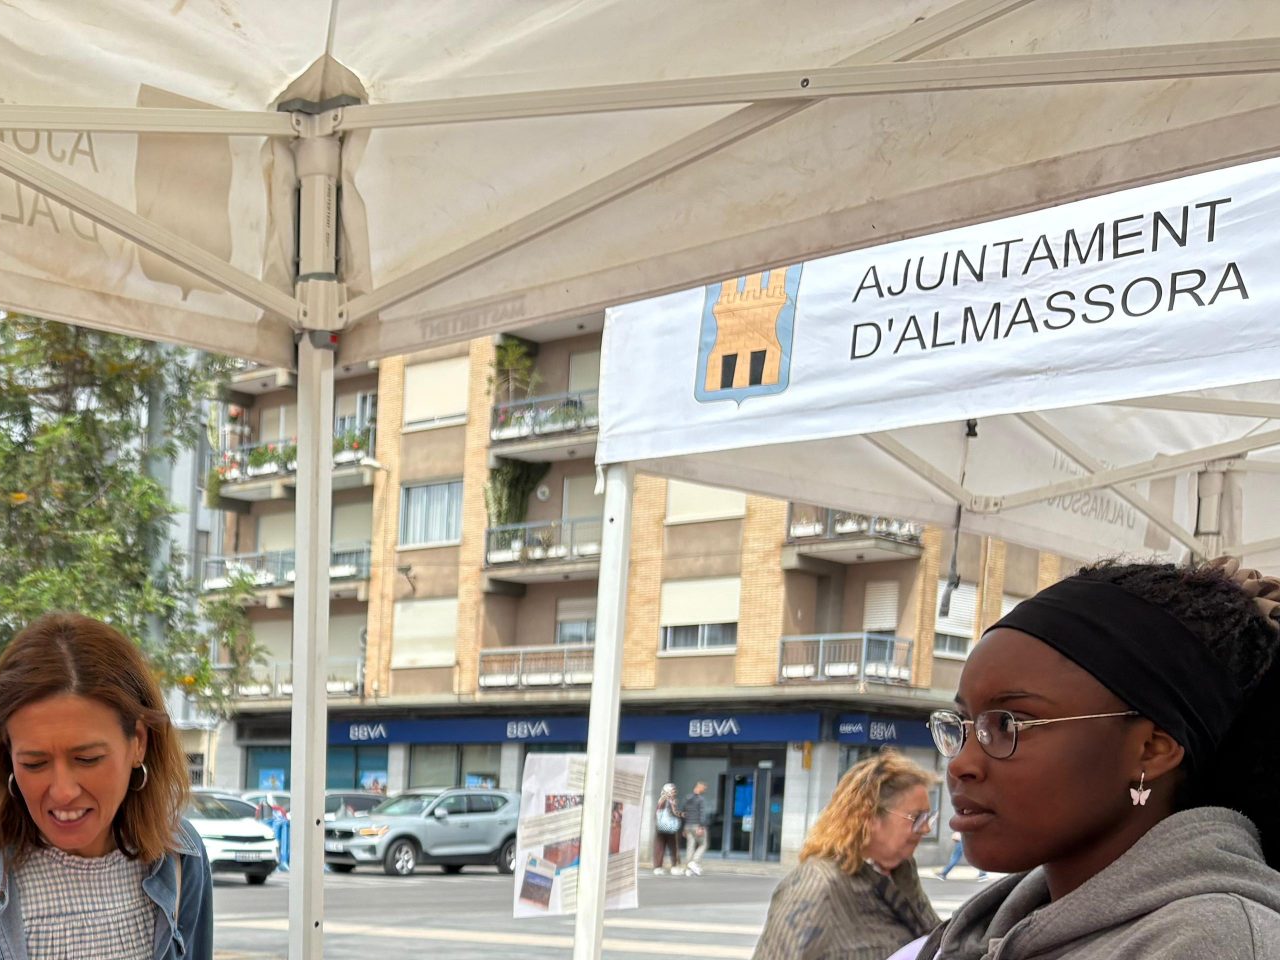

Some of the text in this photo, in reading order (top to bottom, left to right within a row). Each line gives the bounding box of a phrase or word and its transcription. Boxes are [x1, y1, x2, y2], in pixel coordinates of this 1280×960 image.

[852, 197, 1232, 302] AJUNTAMENT
[850, 262, 1250, 360] D'ALMASSORA
[349, 723, 387, 741] BBVA
[507, 720, 550, 738] BBVA
[689, 718, 740, 738] BBVA
[839, 722, 864, 734] BBVA
[870, 721, 897, 741] BBVA
